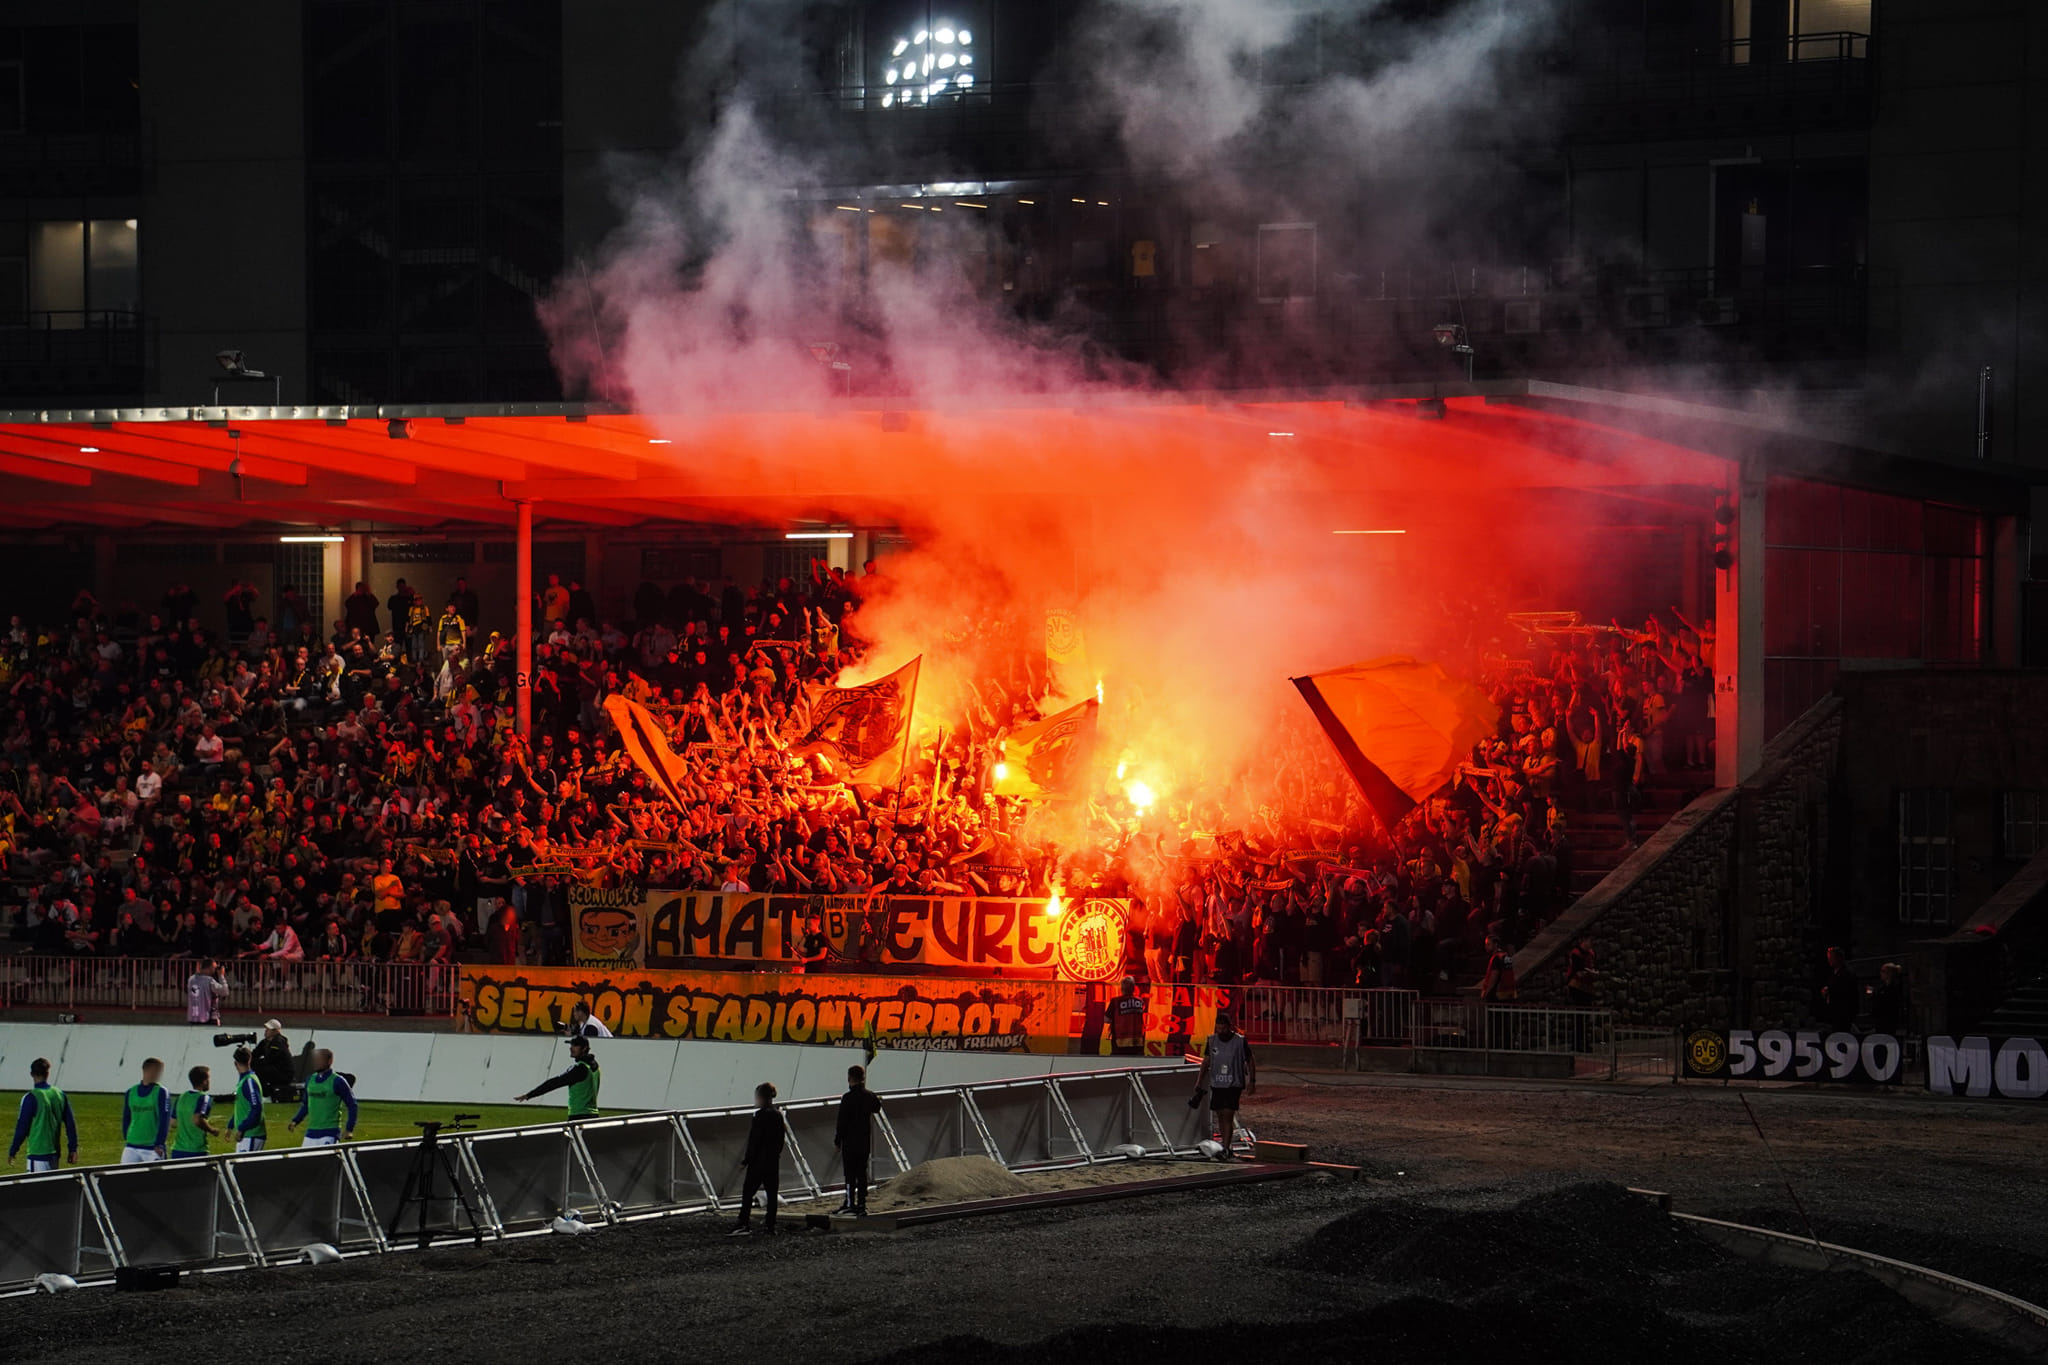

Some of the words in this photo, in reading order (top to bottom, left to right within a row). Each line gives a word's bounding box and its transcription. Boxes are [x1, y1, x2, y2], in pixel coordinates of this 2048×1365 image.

[652, 896, 803, 958] AMAT
[886, 900, 1057, 965] EURE
[663, 995, 1024, 1043] STADIONVERBOT
[834, 1037, 887, 1048] NIEMS
[893, 1037, 957, 1050] VERZAGEN
[963, 1034, 1026, 1050] FREUNDE!
[1695, 1041, 1717, 1058] BVB
[1729, 1029, 1901, 1081] 59590
[1927, 1036, 2048, 1098] MO
